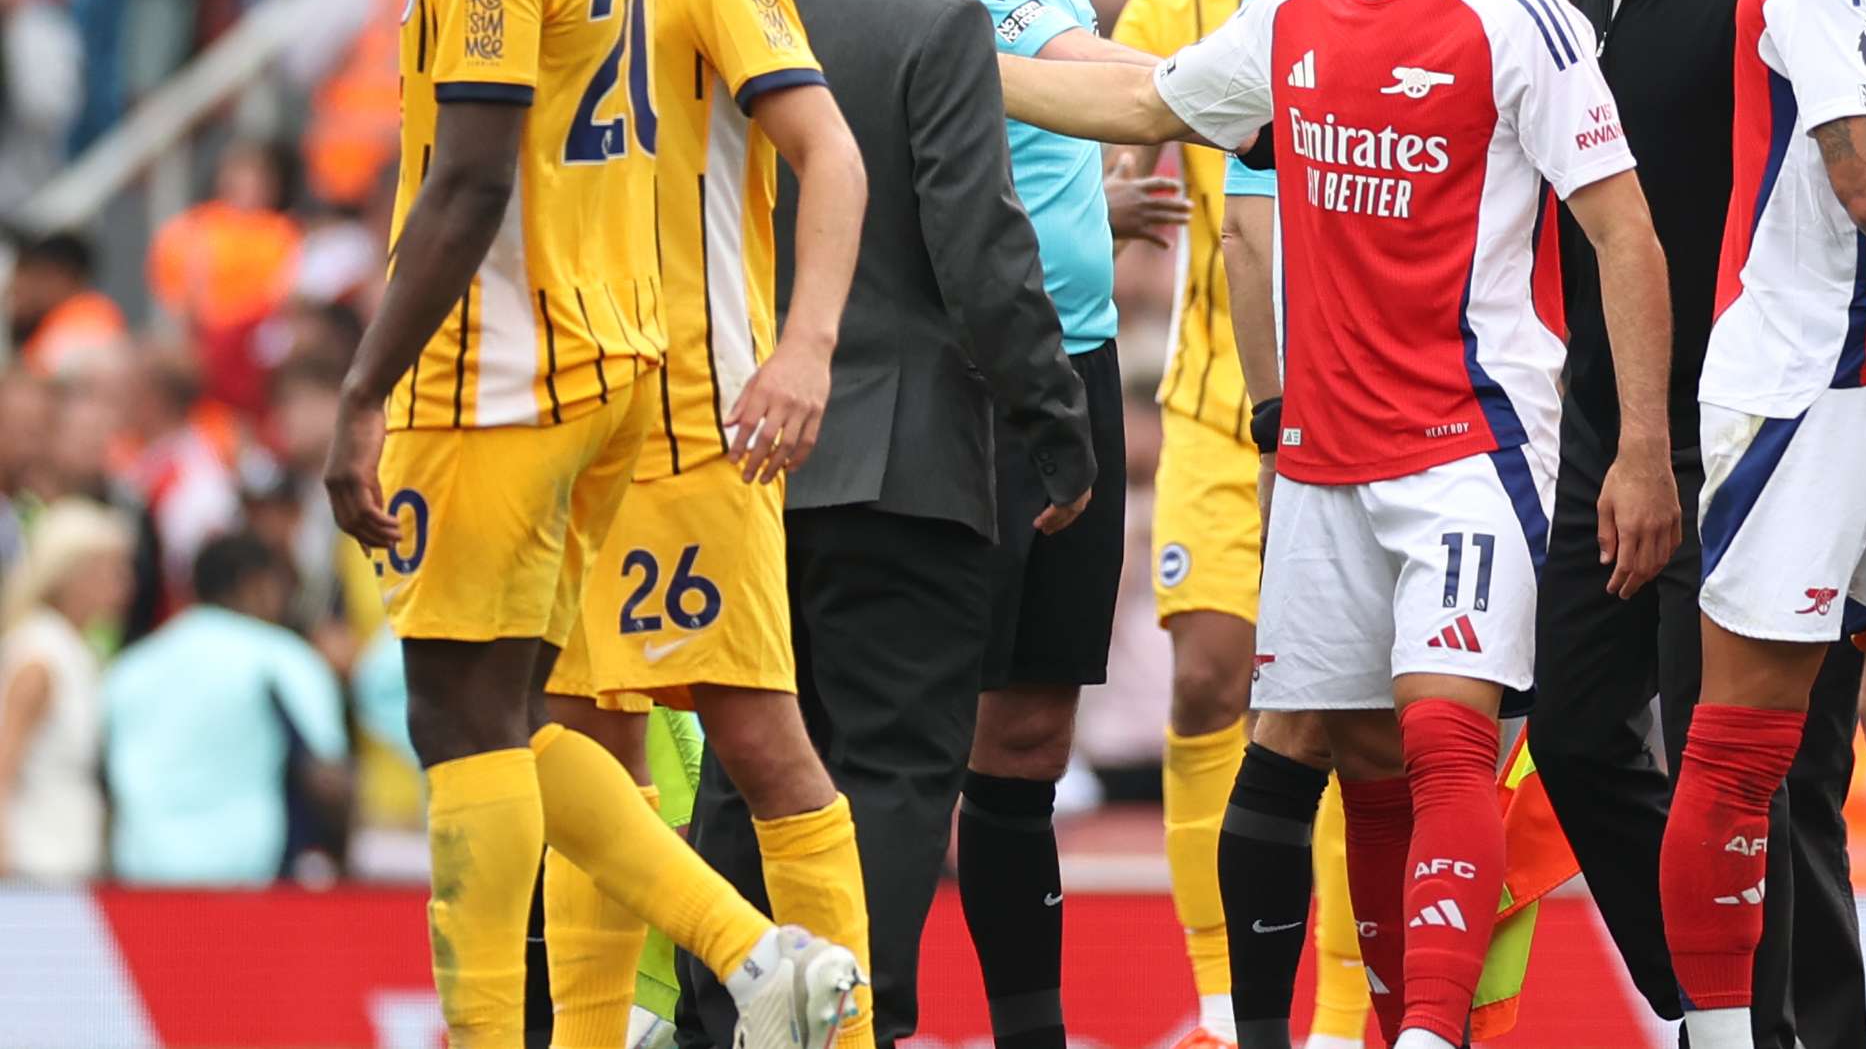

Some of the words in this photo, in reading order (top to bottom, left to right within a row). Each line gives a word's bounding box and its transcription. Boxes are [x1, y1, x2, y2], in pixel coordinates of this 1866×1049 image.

[1289, 107, 1449, 173] Emirates
[1324, 171, 1412, 218] BETTER
[375, 488, 429, 578] 0
[619, 545, 722, 634] 26
[1441, 531, 1495, 612] 11
[1414, 858, 1477, 880] AFC
